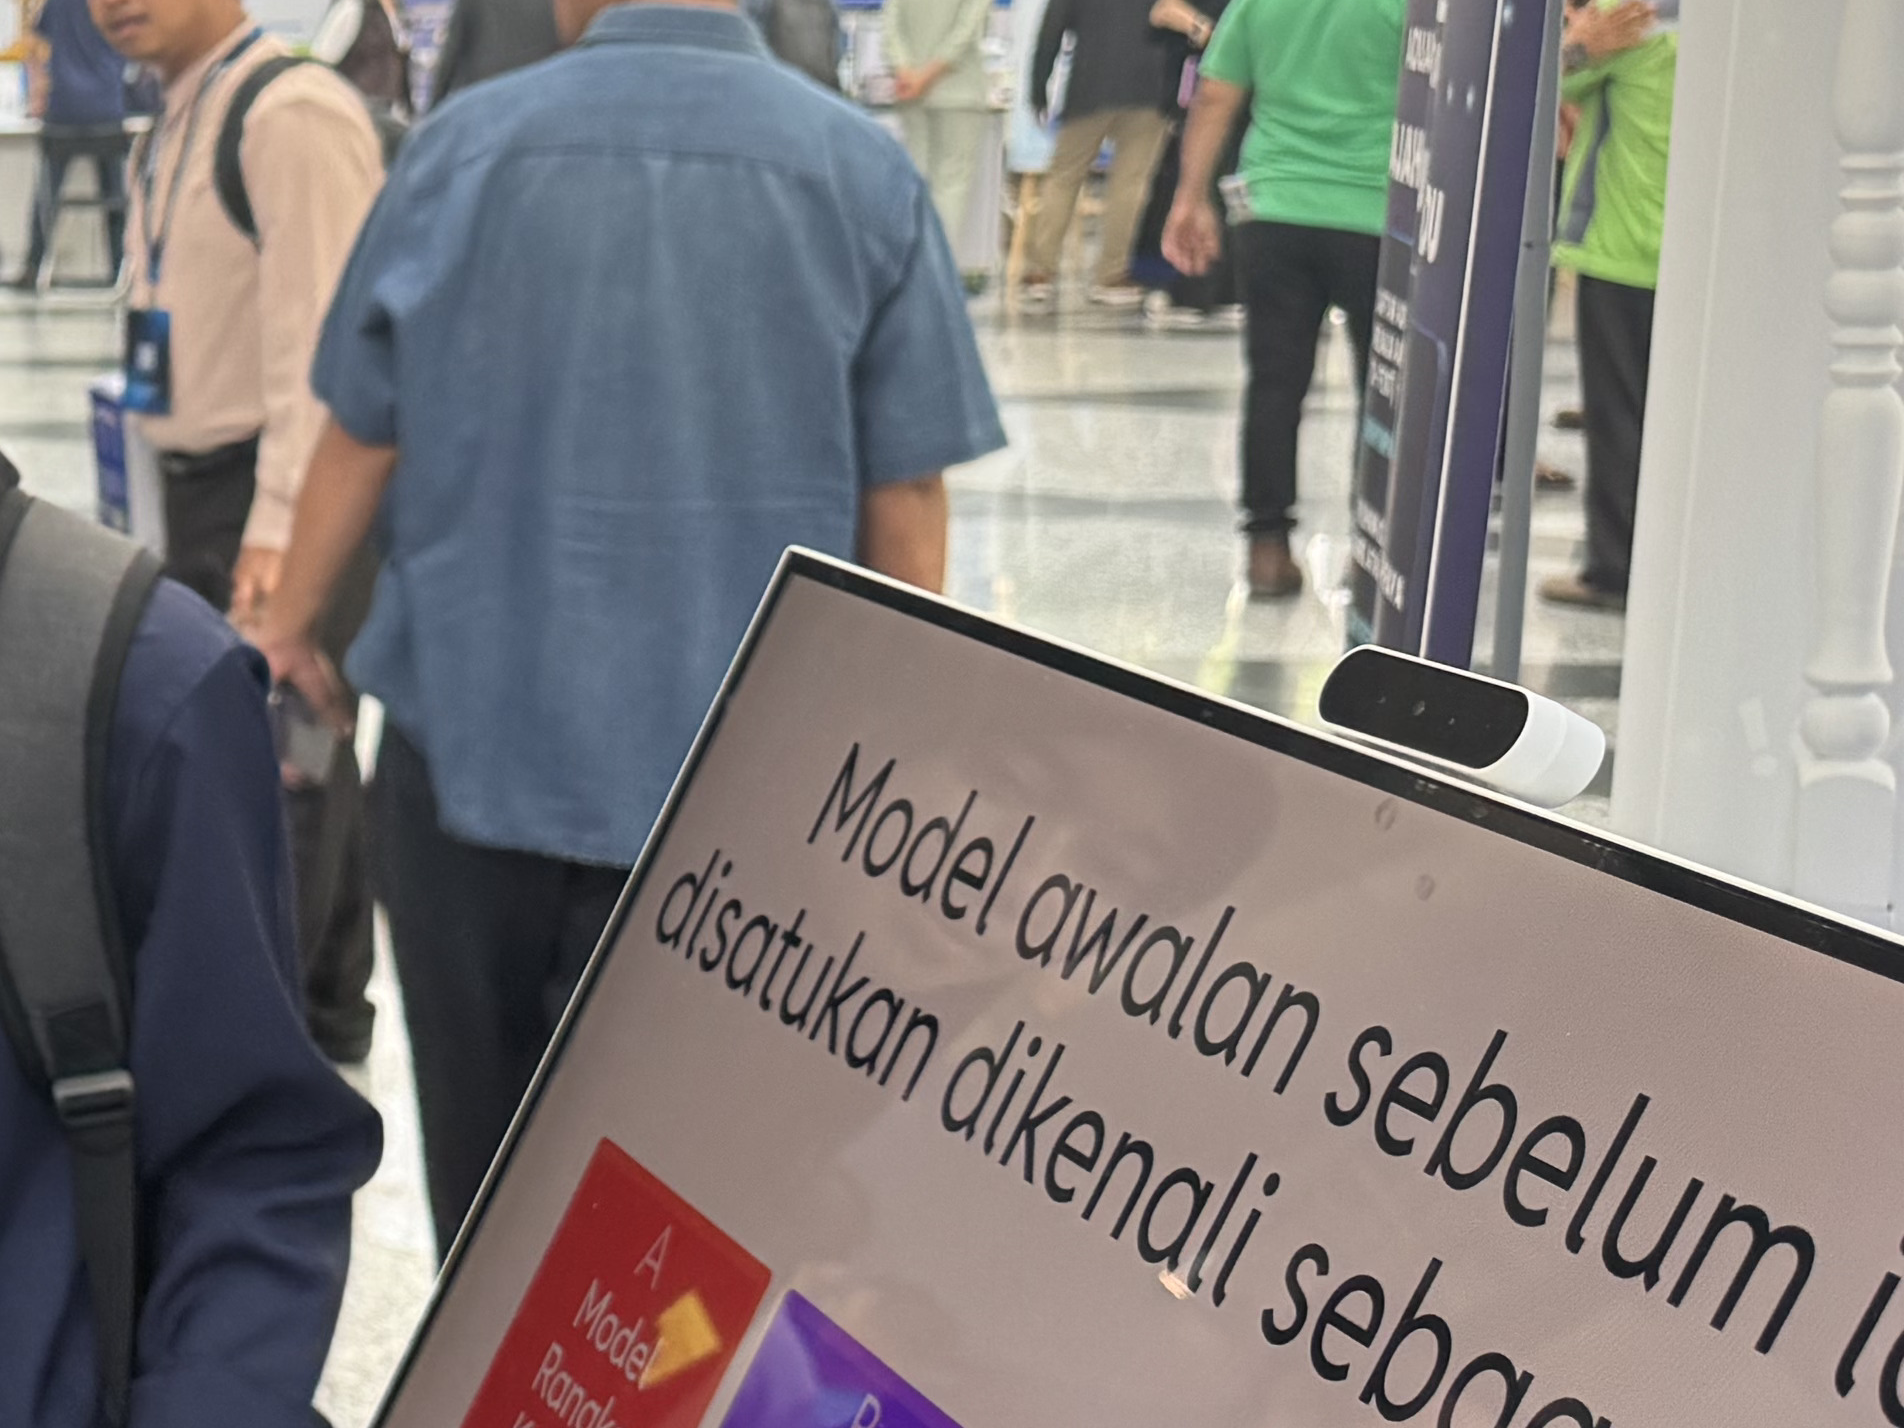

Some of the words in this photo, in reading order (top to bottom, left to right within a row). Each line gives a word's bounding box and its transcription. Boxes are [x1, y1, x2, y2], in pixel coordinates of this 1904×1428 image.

[656, 850, 939, 1101] disatukan
[942, 1021, 1280, 1307] dikenali
[808, 743, 1035, 936] Model
[1016, 874, 1320, 1095] awalan
[1324, 1026, 1815, 1354] sebelum
[574, 1279, 665, 1390] Model
[634, 1225, 672, 1289] A
